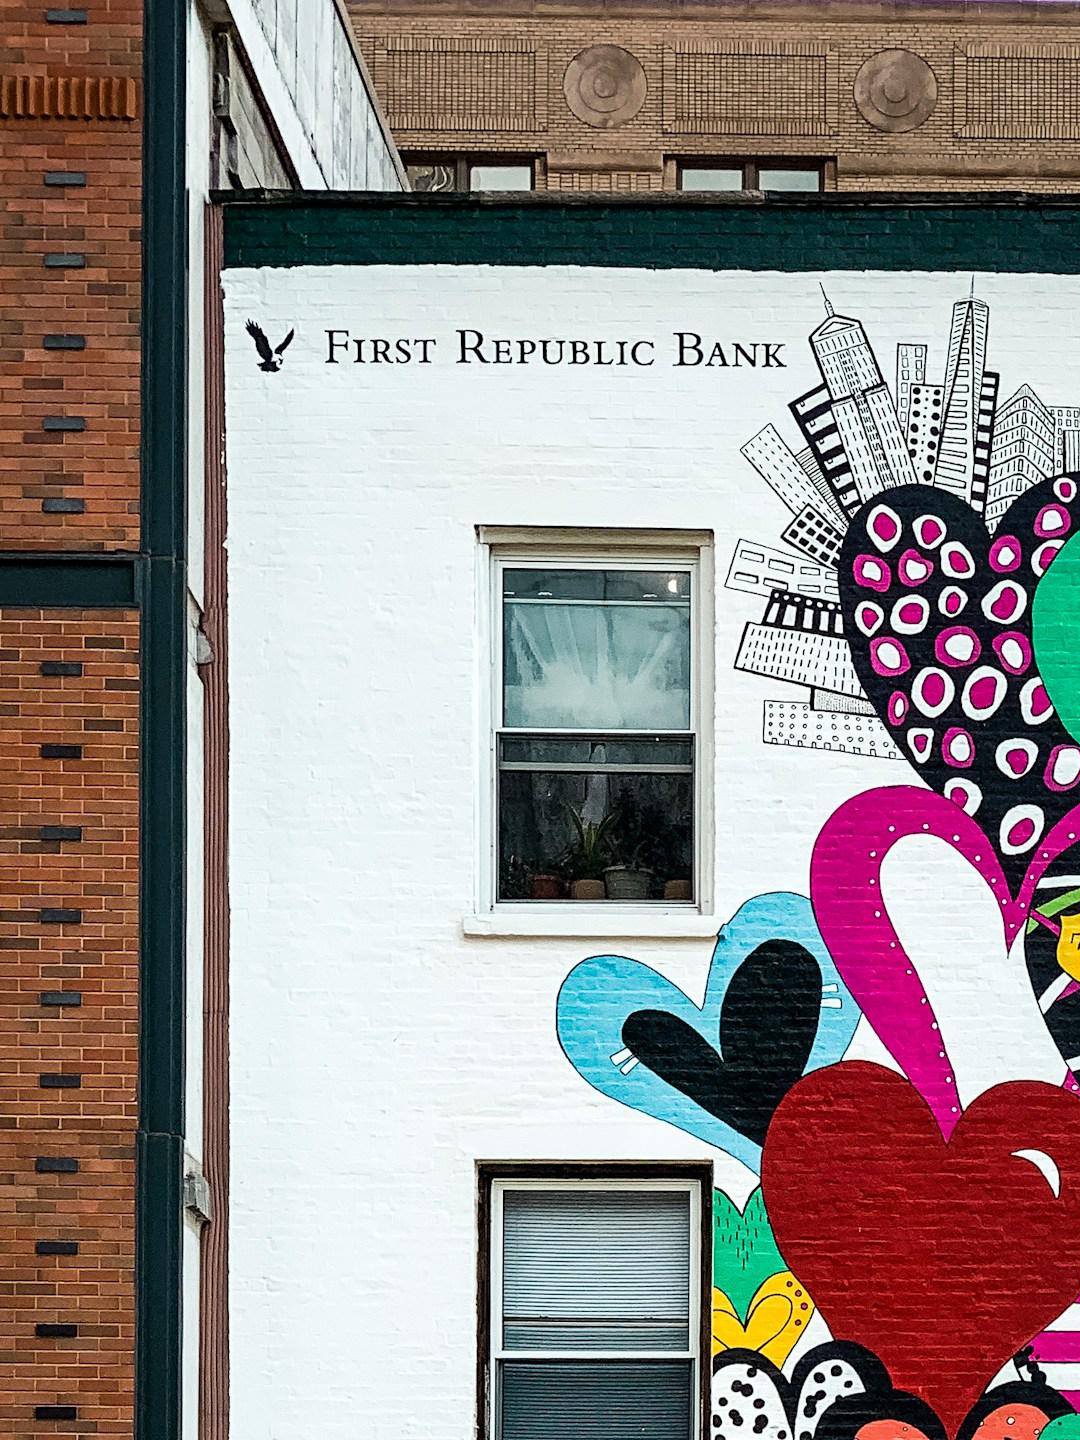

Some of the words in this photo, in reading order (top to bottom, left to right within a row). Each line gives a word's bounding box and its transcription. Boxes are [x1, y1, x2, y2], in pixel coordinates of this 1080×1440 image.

[324, 329, 437, 364] FIRST
[455, 329, 655, 366] REPUBLIC
[672, 332, 787, 368] BANK
